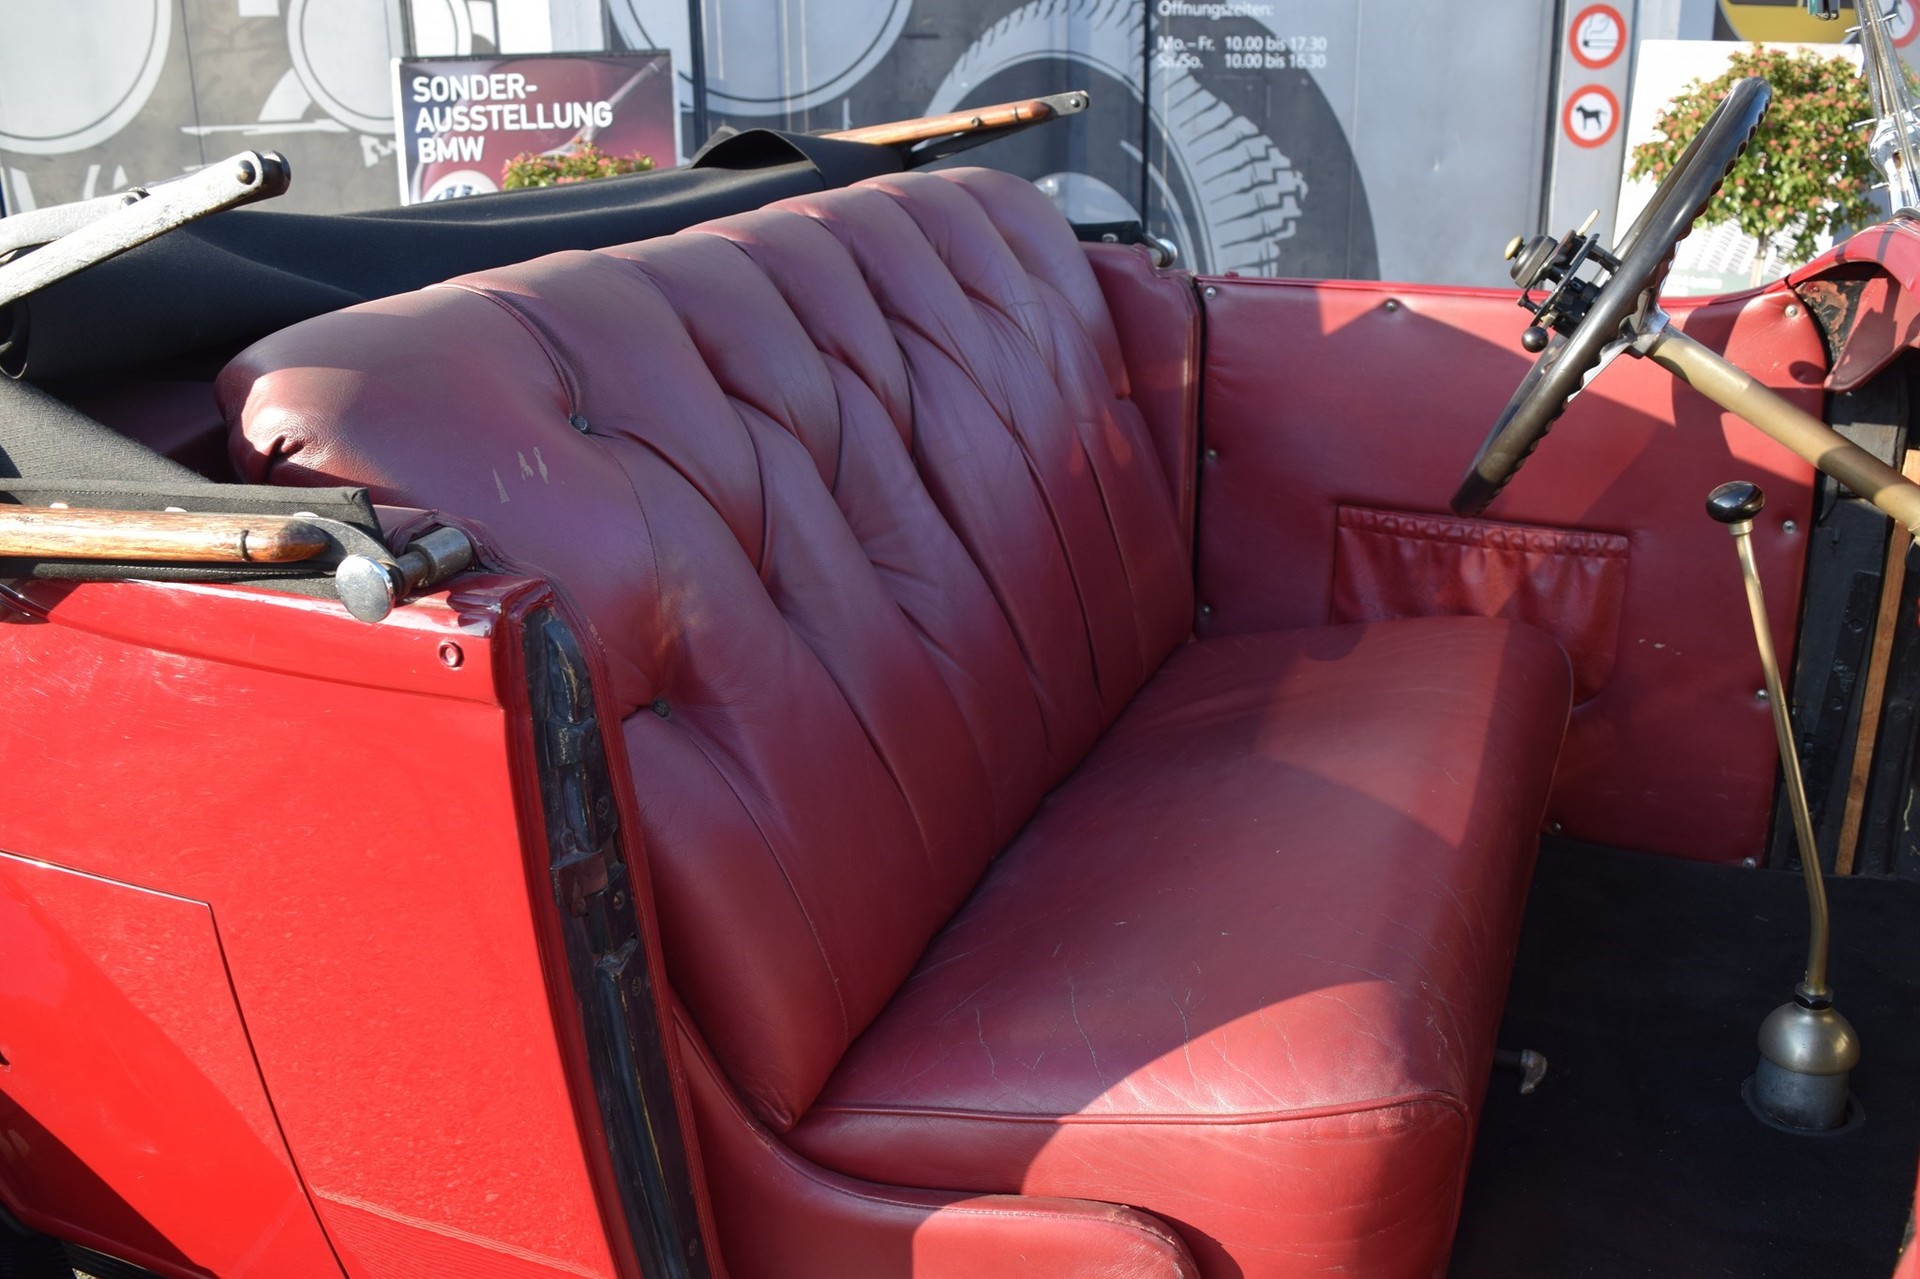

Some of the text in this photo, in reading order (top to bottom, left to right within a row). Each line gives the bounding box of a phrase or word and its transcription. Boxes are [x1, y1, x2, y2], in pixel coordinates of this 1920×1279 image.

[1225, 36, 1263, 51] 10.00
[1265, 36, 1286, 51] bis
[1291, 36, 1327, 51] 17.30
[1225, 53, 1263, 69] 10.00
[1265, 53, 1286, 69] bis
[1290, 53, 1327, 69] 16.30
[412, 73, 538, 103] SONDER-
[415, 101, 613, 133] AUSSTELLUNG
[417, 136, 484, 163] BMW
